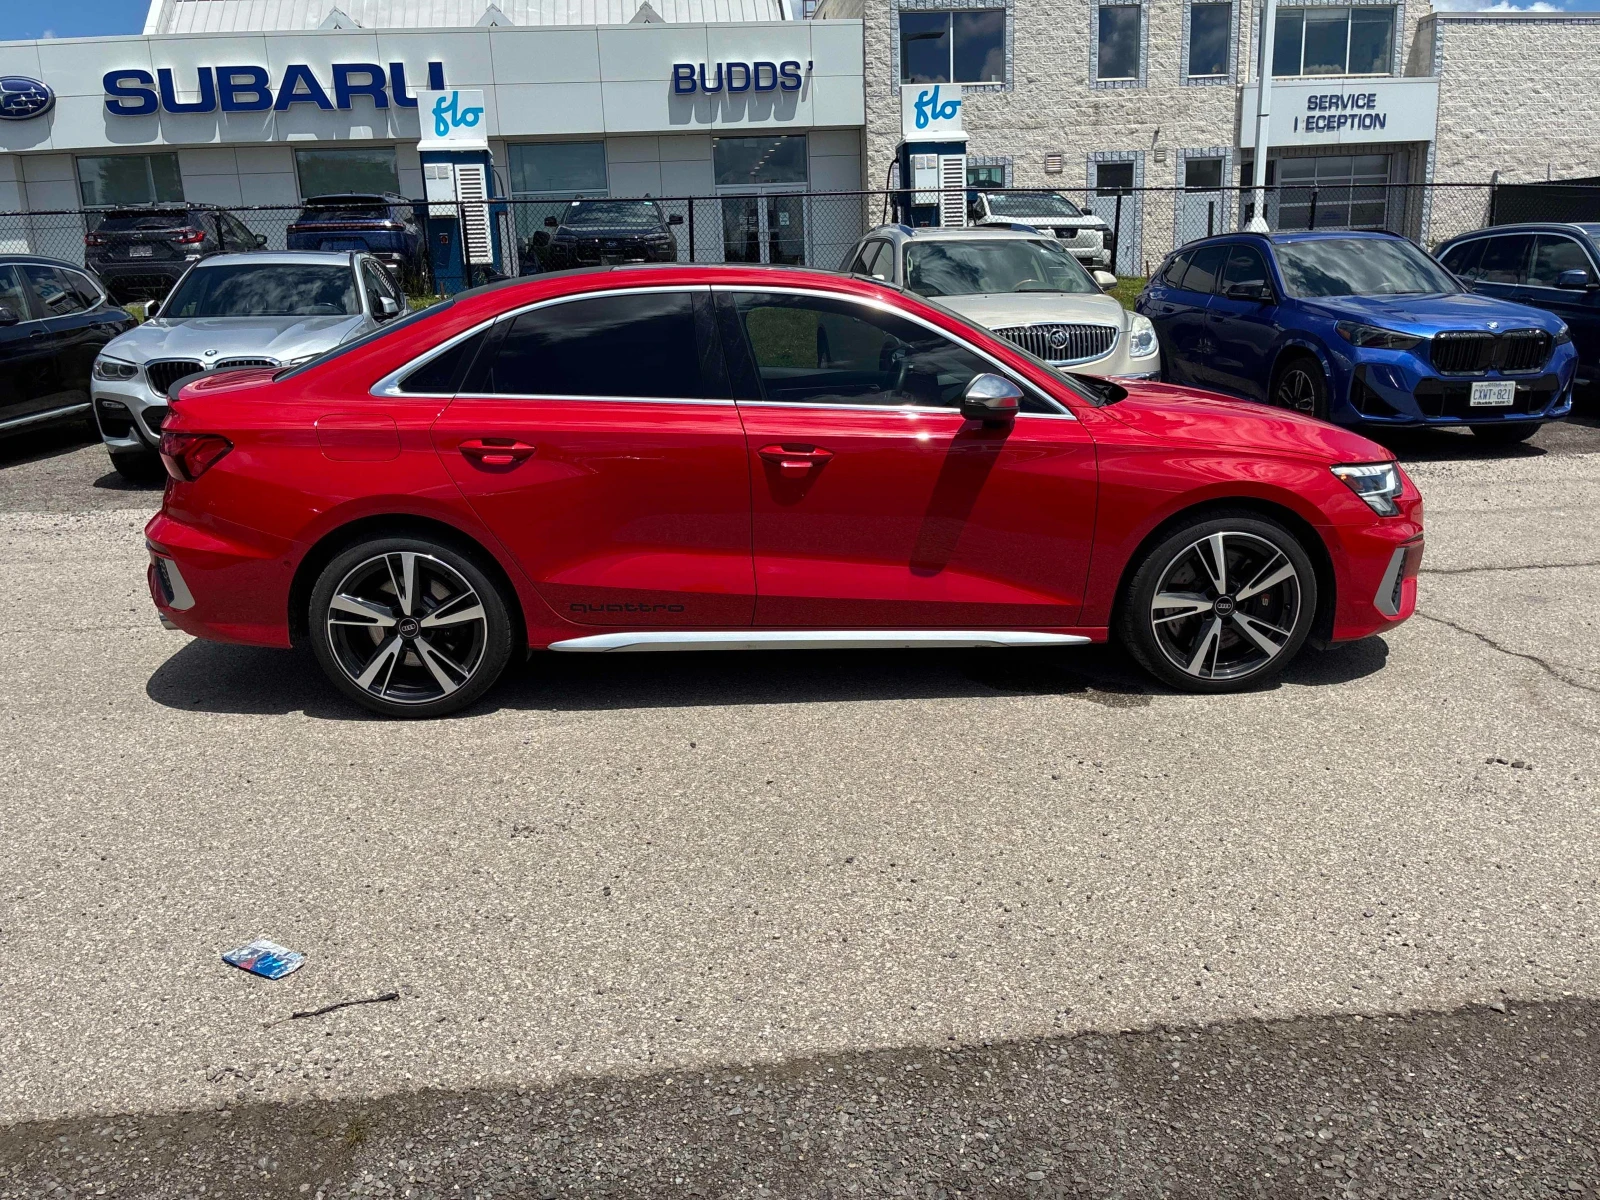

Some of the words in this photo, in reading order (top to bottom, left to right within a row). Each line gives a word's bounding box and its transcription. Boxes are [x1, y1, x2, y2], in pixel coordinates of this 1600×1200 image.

[103, 62, 445, 116] SUBARU
[673, 60, 814, 94] BUDDS'
[432, 91, 484, 137] flo
[914, 85, 962, 129] flo
[1307, 93, 1377, 111] SERVICE
[569, 603, 685, 614] quattro
